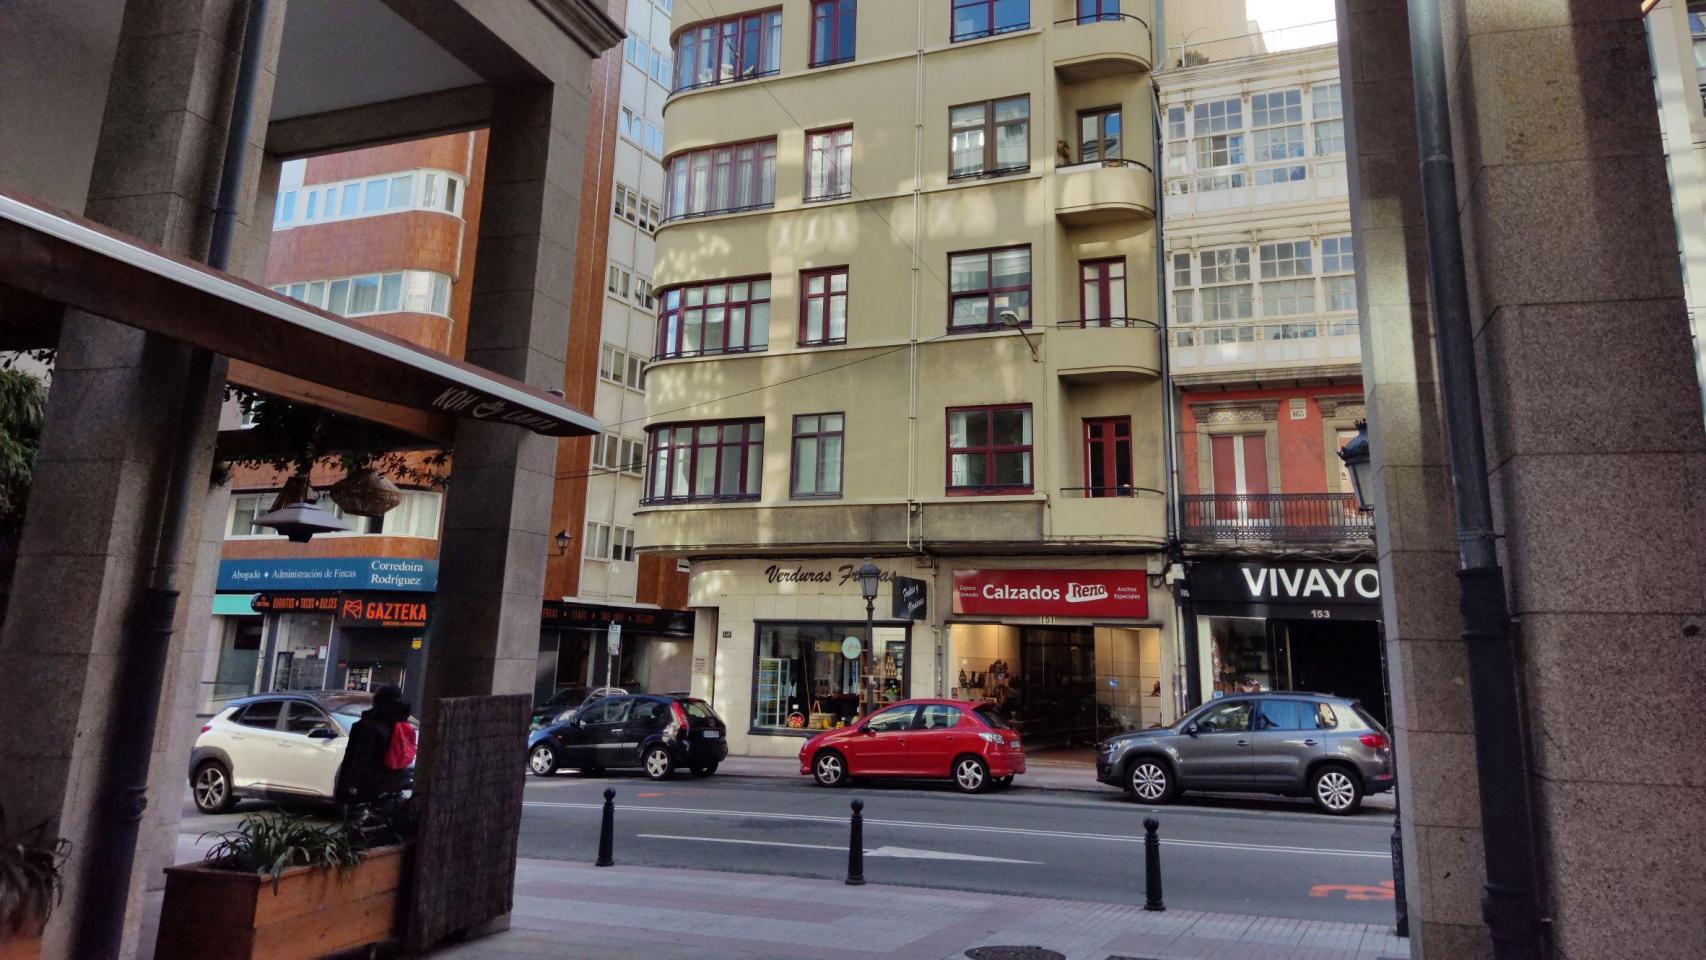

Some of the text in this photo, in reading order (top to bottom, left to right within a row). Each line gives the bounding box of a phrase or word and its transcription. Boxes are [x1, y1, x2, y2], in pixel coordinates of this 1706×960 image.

[432, 386, 479, 410] KOH
[371, 560, 423, 572] Corredoira
[232, 568, 357, 581] Abogado Administración de Fincas
[371, 574, 422, 587] Rodríguez
[764, 565, 833, 583] Verduras
[1241, 568, 1380, 598] VIVAYO
[982, 584, 1060, 600] Calzados
[1071, 584, 1105, 598] Reno
[366, 602, 427, 621] GAZTEKA
[1310, 609, 1331, 619] 153
